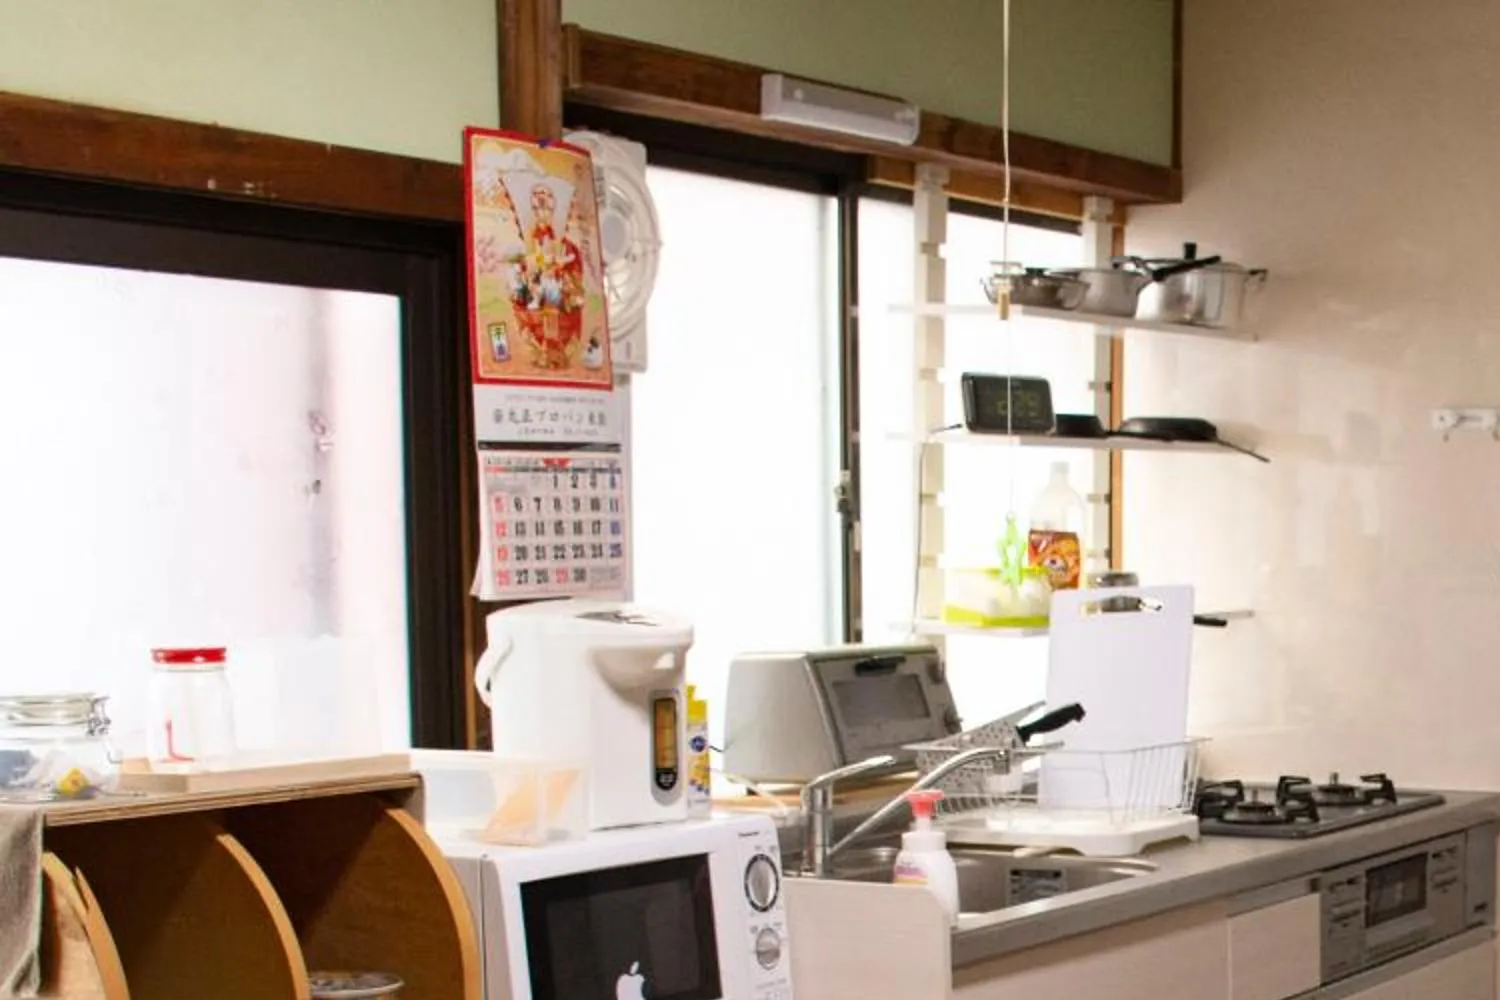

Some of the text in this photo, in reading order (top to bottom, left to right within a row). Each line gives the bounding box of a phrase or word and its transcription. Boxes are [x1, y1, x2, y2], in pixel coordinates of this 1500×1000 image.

[552, 473, 559, 489] 1
[513, 496, 523, 512] 6
[533, 496, 542, 512] 7
[608, 498, 619, 513] 11
[514, 521, 527, 536] 13
[553, 520, 565, 535] 15
[590, 520, 602, 535] 17
[514, 545, 528, 560] 20
[534, 545, 547, 560] 21
[553, 544, 566, 559] 22
[572, 544, 585, 559] 23
[590, 544, 604, 558] 24
[609, 543, 622, 558] 25
[515, 569, 529, 585] 27
